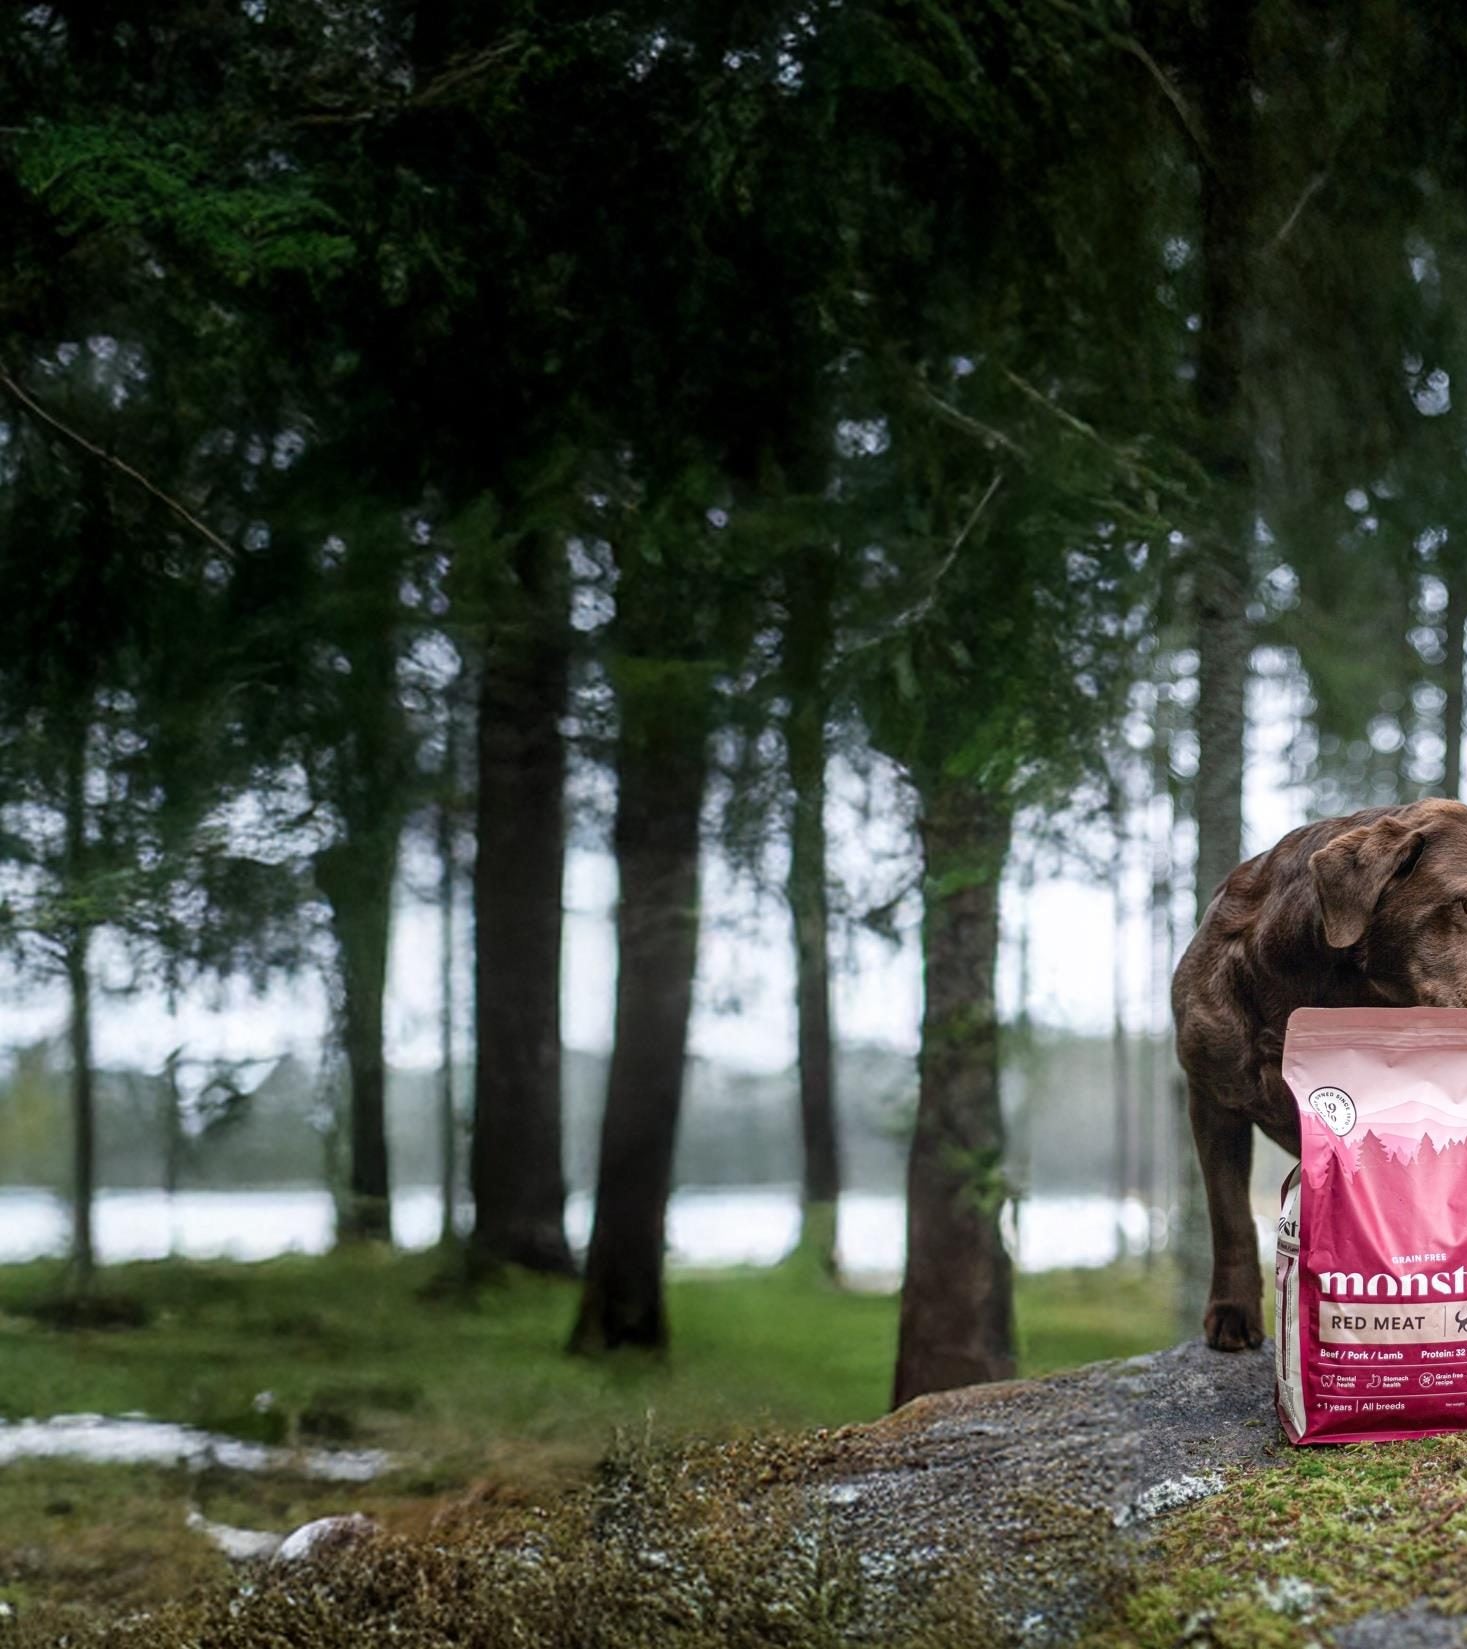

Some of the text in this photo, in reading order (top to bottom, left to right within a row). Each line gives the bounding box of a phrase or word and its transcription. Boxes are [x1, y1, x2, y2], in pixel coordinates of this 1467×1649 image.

[1391, 1253, 1447, 1265] GRAIN FREE
[1332, 1315, 1426, 1330] RED MEAT
[1320, 1348, 1339, 1358] Beef
[1347, 1351, 1369, 1360] Pork
[1377, 1350, 1404, 1360] Lamb
[1421, 1350, 1454, 1359] Protein:
[1455, 1348, 1466, 1357] 32
[1329, 1403, 1353, 1413] years
[1361, 1402, 1405, 1410] All breeds
